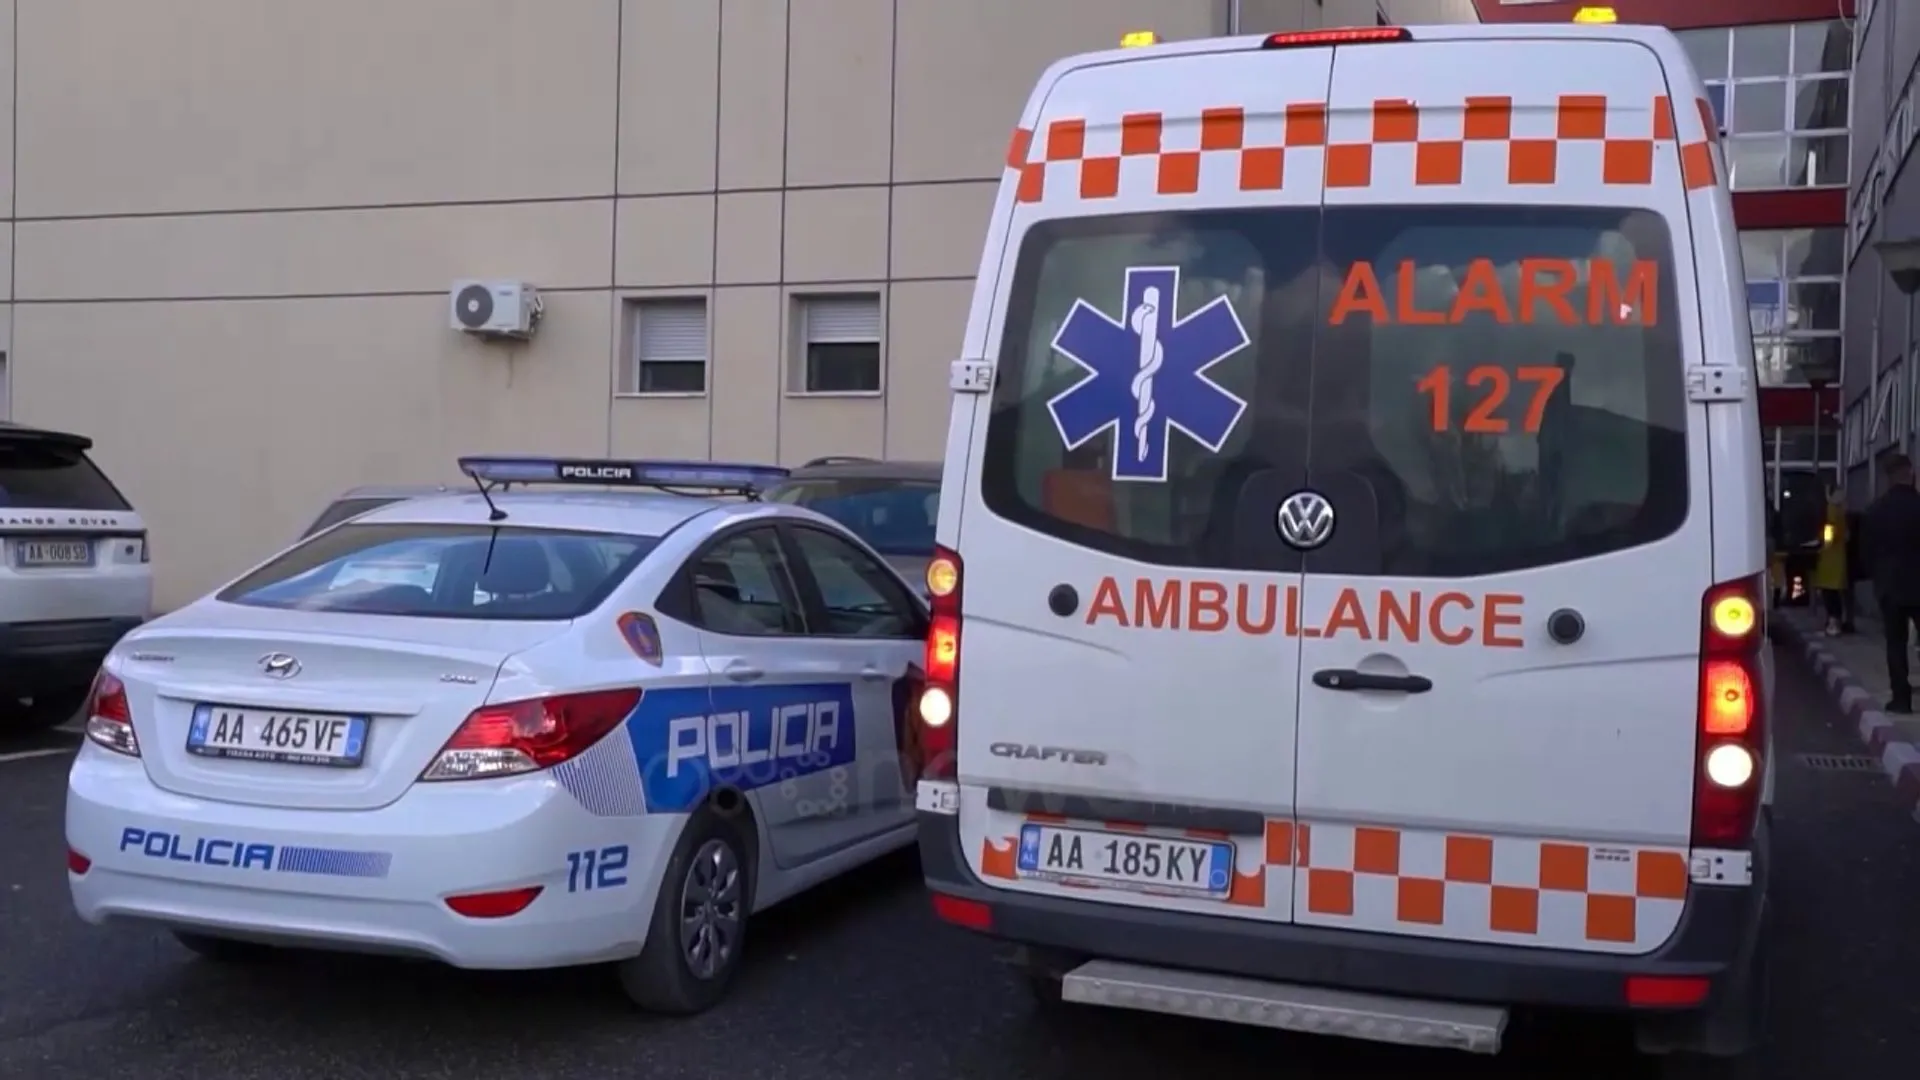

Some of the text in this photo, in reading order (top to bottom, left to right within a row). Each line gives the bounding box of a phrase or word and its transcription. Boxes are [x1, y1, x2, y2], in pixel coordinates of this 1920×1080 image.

[1329, 258, 1659, 326] ALARM
[1416, 364, 1566, 434] 127
[562, 465, 632, 479] POLICIA
[1085, 576, 1525, 648] AMBULANCE
[212, 711, 245, 745] AA
[666, 700, 840, 778] POLICIA
[990, 742, 1108, 766] CRAFTER
[119, 827, 275, 871] POLICIA
[566, 845, 629, 893] 112
[1047, 834, 1083, 869] AA
